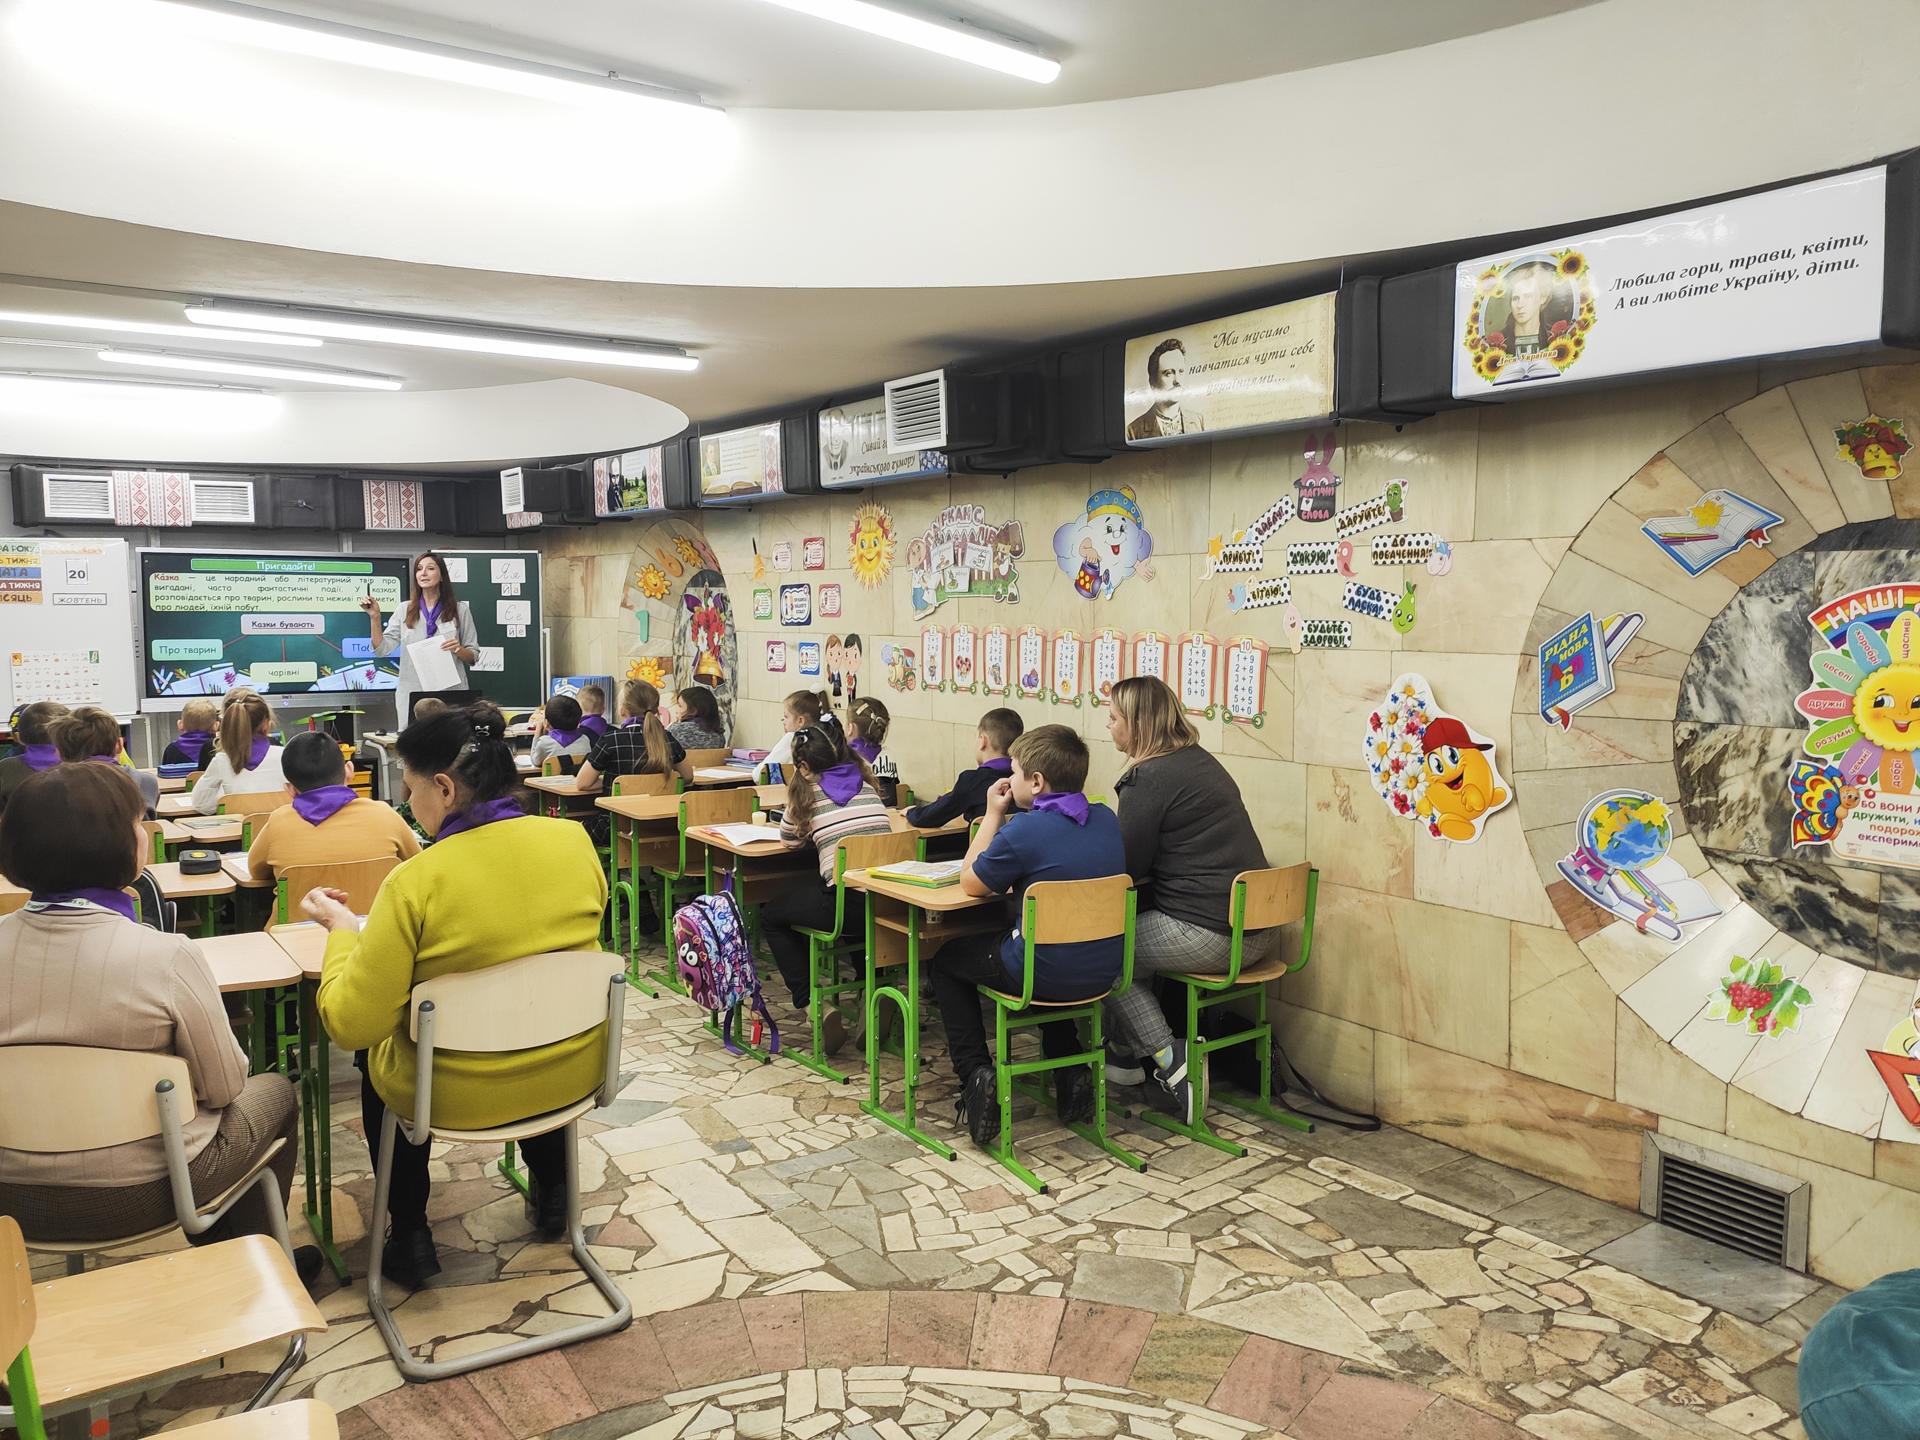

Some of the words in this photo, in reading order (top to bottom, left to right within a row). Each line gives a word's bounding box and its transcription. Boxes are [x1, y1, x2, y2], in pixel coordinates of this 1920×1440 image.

[1609, 270, 1676, 292] Любила
[1680, 261, 1723, 279] гори,
[1729, 248, 1795, 270] трави,
[1802, 233, 1868, 256] квіти,
[1614, 296, 1625, 310] А
[1629, 295, 1649, 307] ви
[1652, 282, 1719, 304] любіте
[1723, 268, 1800, 291] Україну,
[1806, 257, 1860, 276] діти.
[1242, 325, 1290, 344] мусимо
[1189, 355, 1250, 375] навчатися
[1254, 348, 1287, 364] чути
[1290, 338, 1315, 356] себе
[0, 568, 28, 577] АТА
[68, 569, 86, 579] 20
[256, 561, 316, 572] Пригадайте!
[224, 575, 266, 583] народний
[154, 594, 221, 602] розповідається
[1355, 586, 1382, 602] БУДЬ
[156, 604, 171, 612] про
[1825, 589, 1904, 629] НАШІ
[251, 620, 276, 628] Казки
[280, 620, 315, 628] бувають
[635, 609, 650, 643] 1
[159, 645, 180, 655] Про
[183, 646, 217, 655] тварин
[1544, 623, 1588, 662] РІДНА
[1559, 636, 1589, 664] МОВА
[1808, 699, 1846, 709] дружні
[1814, 727, 1855, 749] розумні
[1850, 749, 1871, 774] чемні
[1892, 760, 1902, 787] добрі
[1861, 800, 1876, 809] БО
[1880, 802, 1912, 813] ВОНИ
[1852, 811, 1909, 825] дружити,
